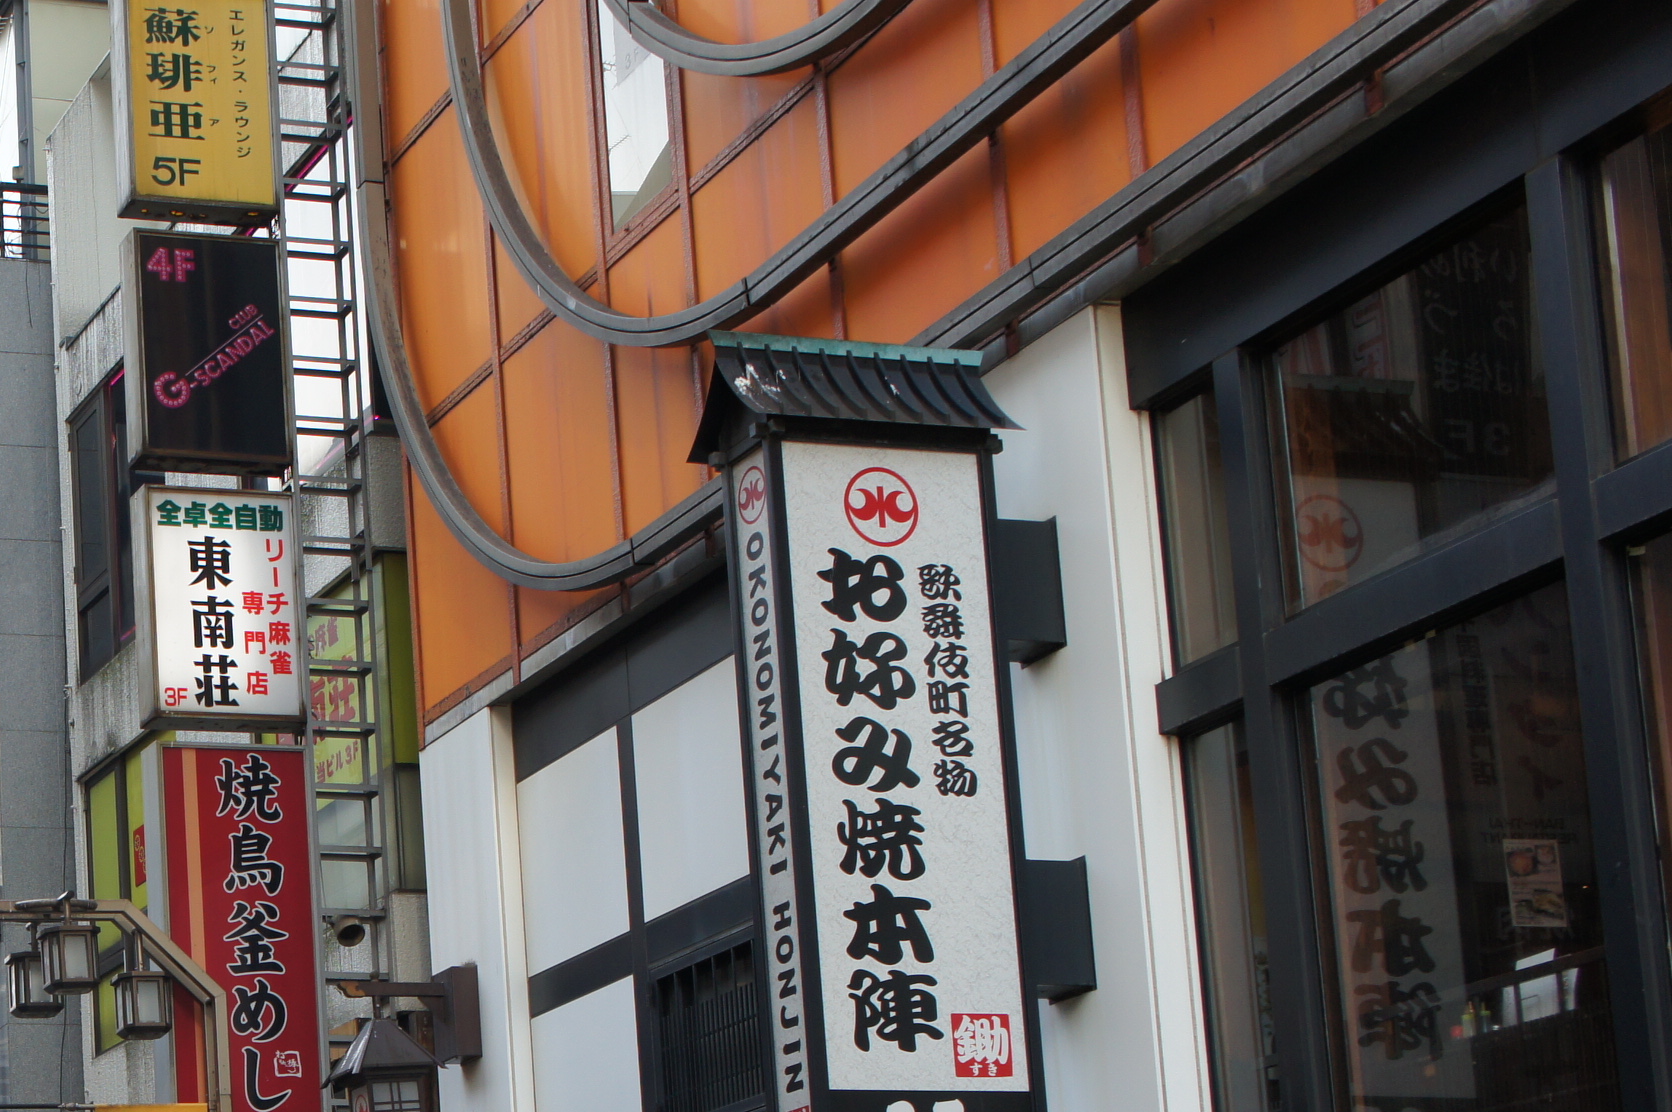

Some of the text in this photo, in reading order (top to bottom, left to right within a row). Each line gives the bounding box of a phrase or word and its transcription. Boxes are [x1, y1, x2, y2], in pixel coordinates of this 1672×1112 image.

[143, 7, 205, 142] 蘇琲亜
[228, 9, 251, 160] エレガンス・ラウンジ
[151, 156, 202, 187] 5F
[147, 247, 195, 284] 4F
[228, 304, 258, 330] CLUB
[154, 317, 276, 408] G-SCANDAL
[156, 499, 283, 532] 全卓全自動
[187, 536, 240, 707] 東南荘
[241, 590, 269, 695] 専門店
[265, 538, 293, 675] リーチ麻雀
[164, 687, 188, 706] 3F
[916, 563, 978, 798] 歌舞伎町名物
[743, 532, 805, 1094] OKONOMIYAKI HONJIN
[817, 547, 944, 1053] お好み焼本陣
[216, 753, 289, 1112] 焼鳥釜めし
[953, 1014, 1010, 1065] 鋤
[969, 1062, 998, 1077] すき
